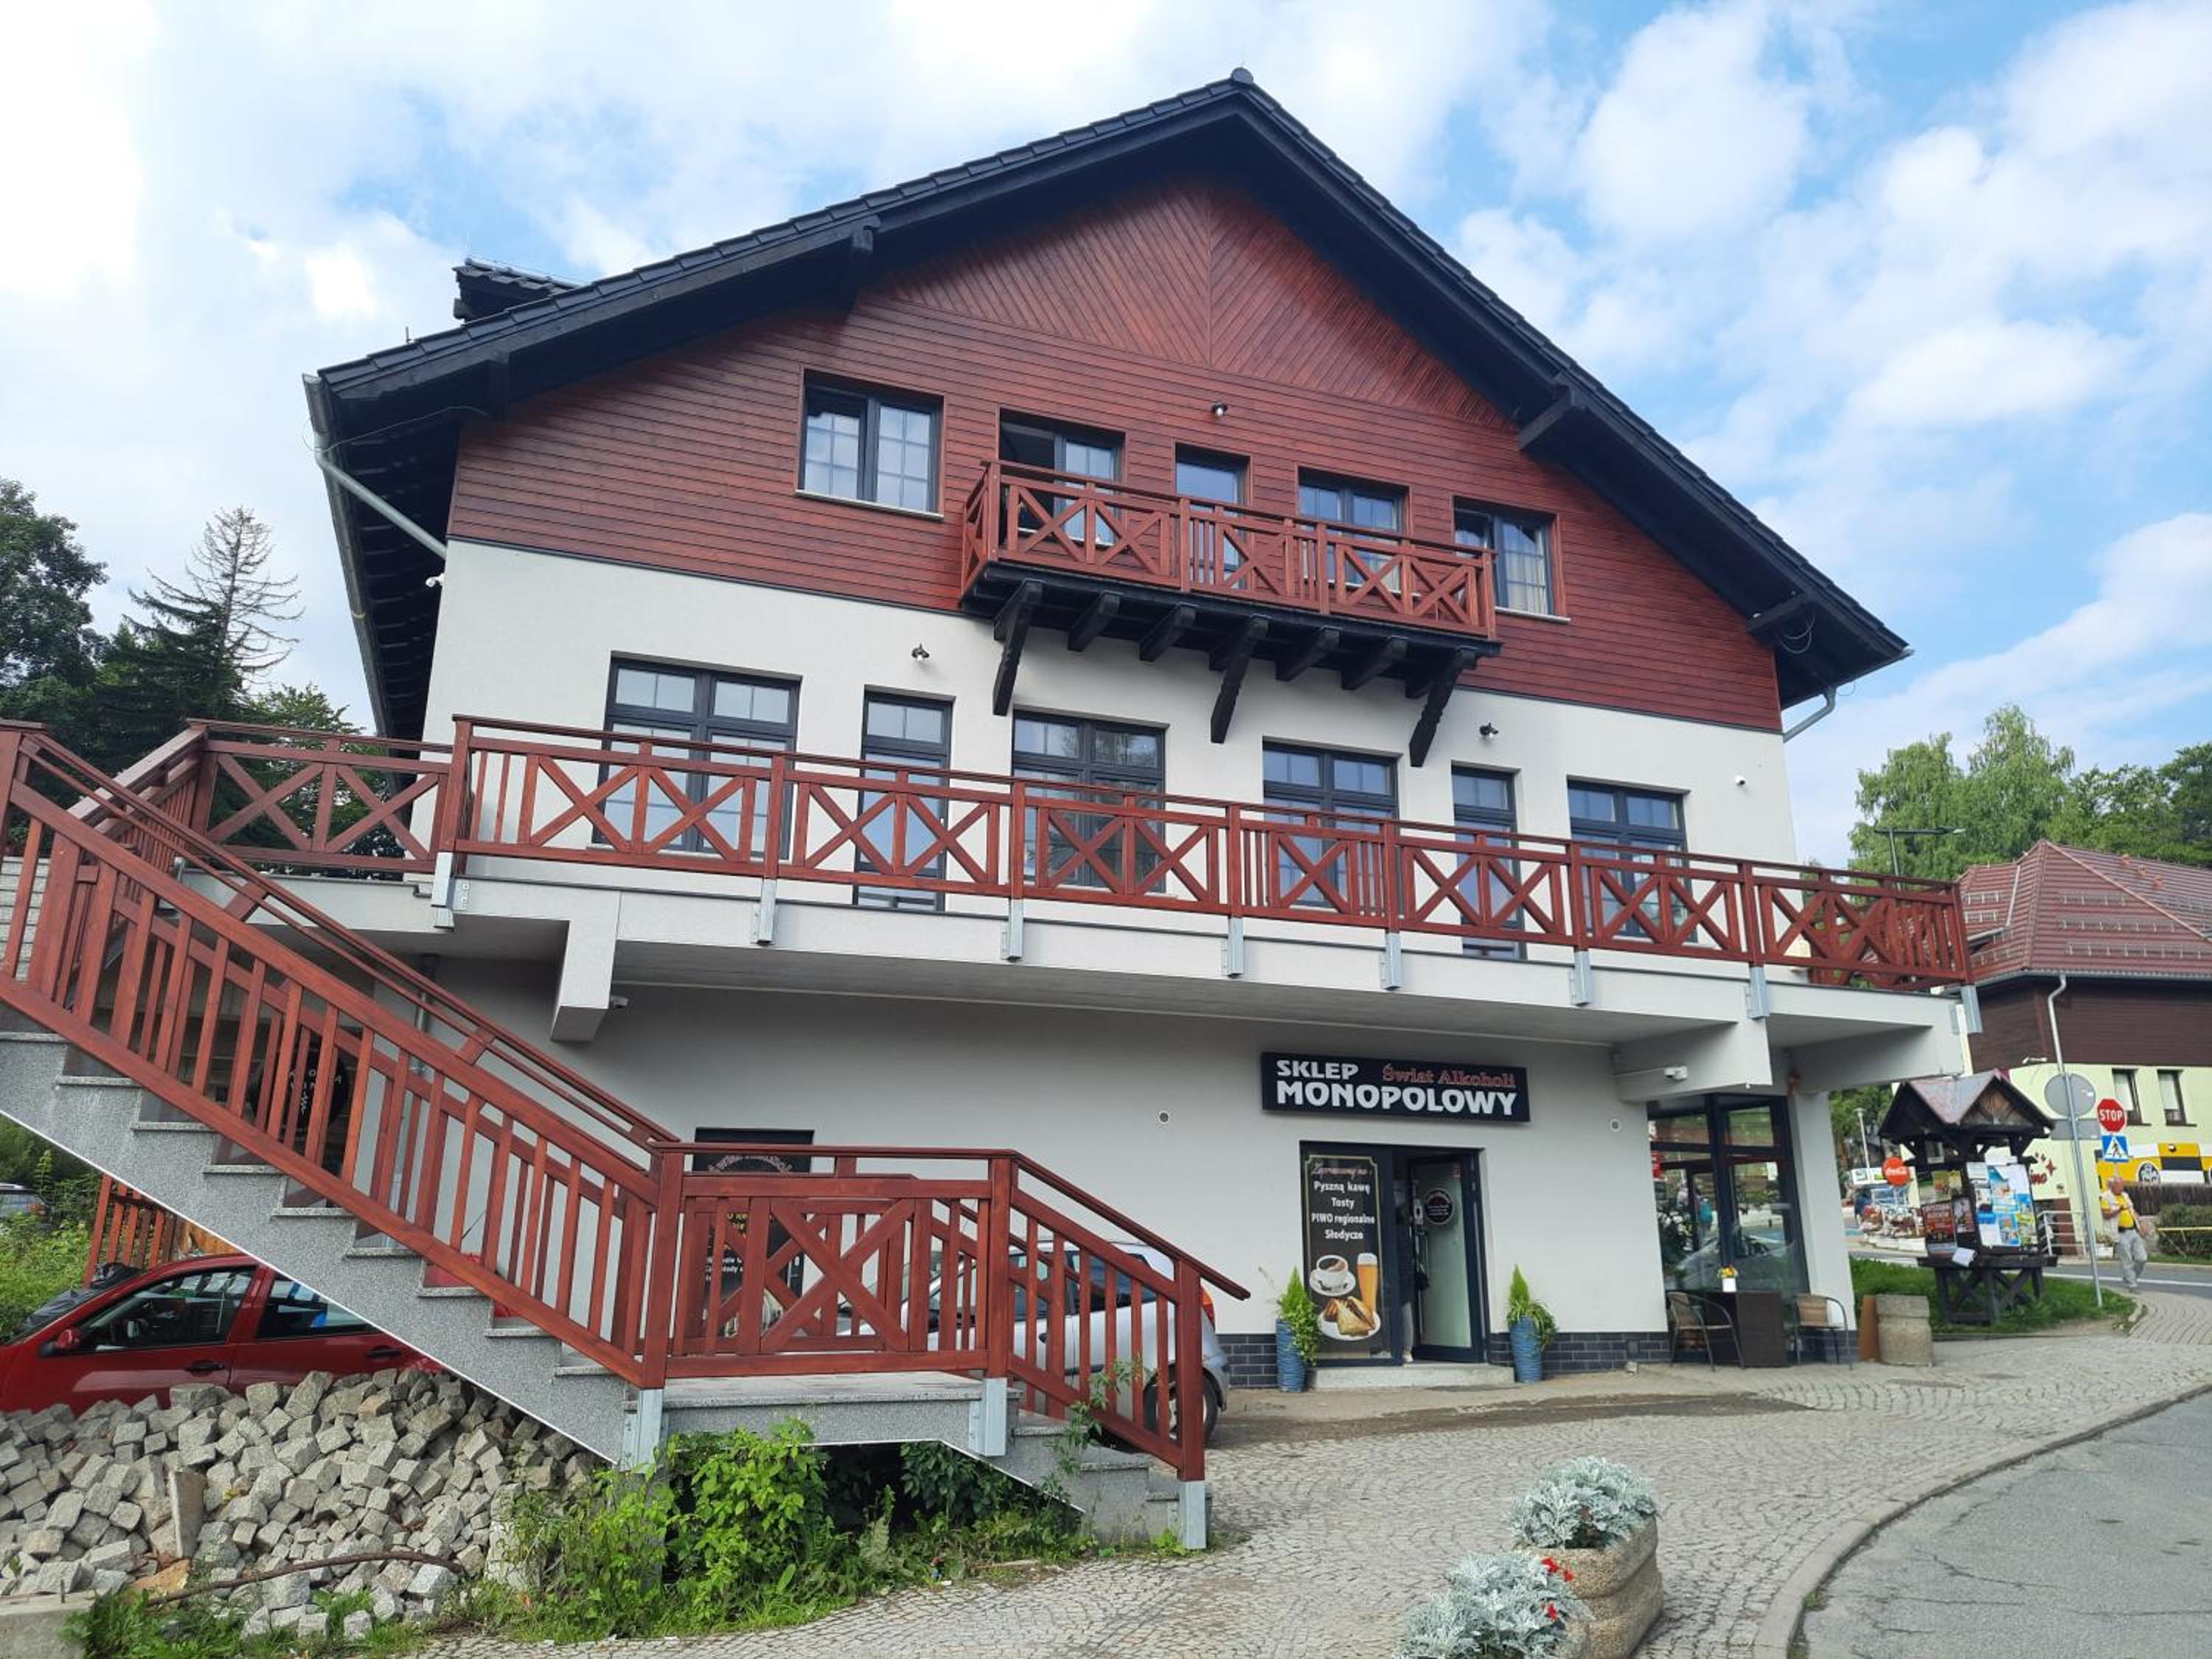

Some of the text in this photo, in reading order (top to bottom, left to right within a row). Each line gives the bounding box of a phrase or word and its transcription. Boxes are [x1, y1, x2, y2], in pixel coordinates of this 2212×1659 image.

[1276, 1060, 1359, 1080] SKLEP
[1382, 1062, 1434, 1083] Świat
[1276, 1080, 1517, 1116] MONOPOLOWY
[2099, 1108, 2123, 1121] STOP
[1313, 1180, 1345, 1194] Pyszną
[1331, 1197, 1354, 1210] Tosty
[1311, 1213, 1333, 1223] PIWO
[1325, 1228, 1363, 1242] Słodycze
